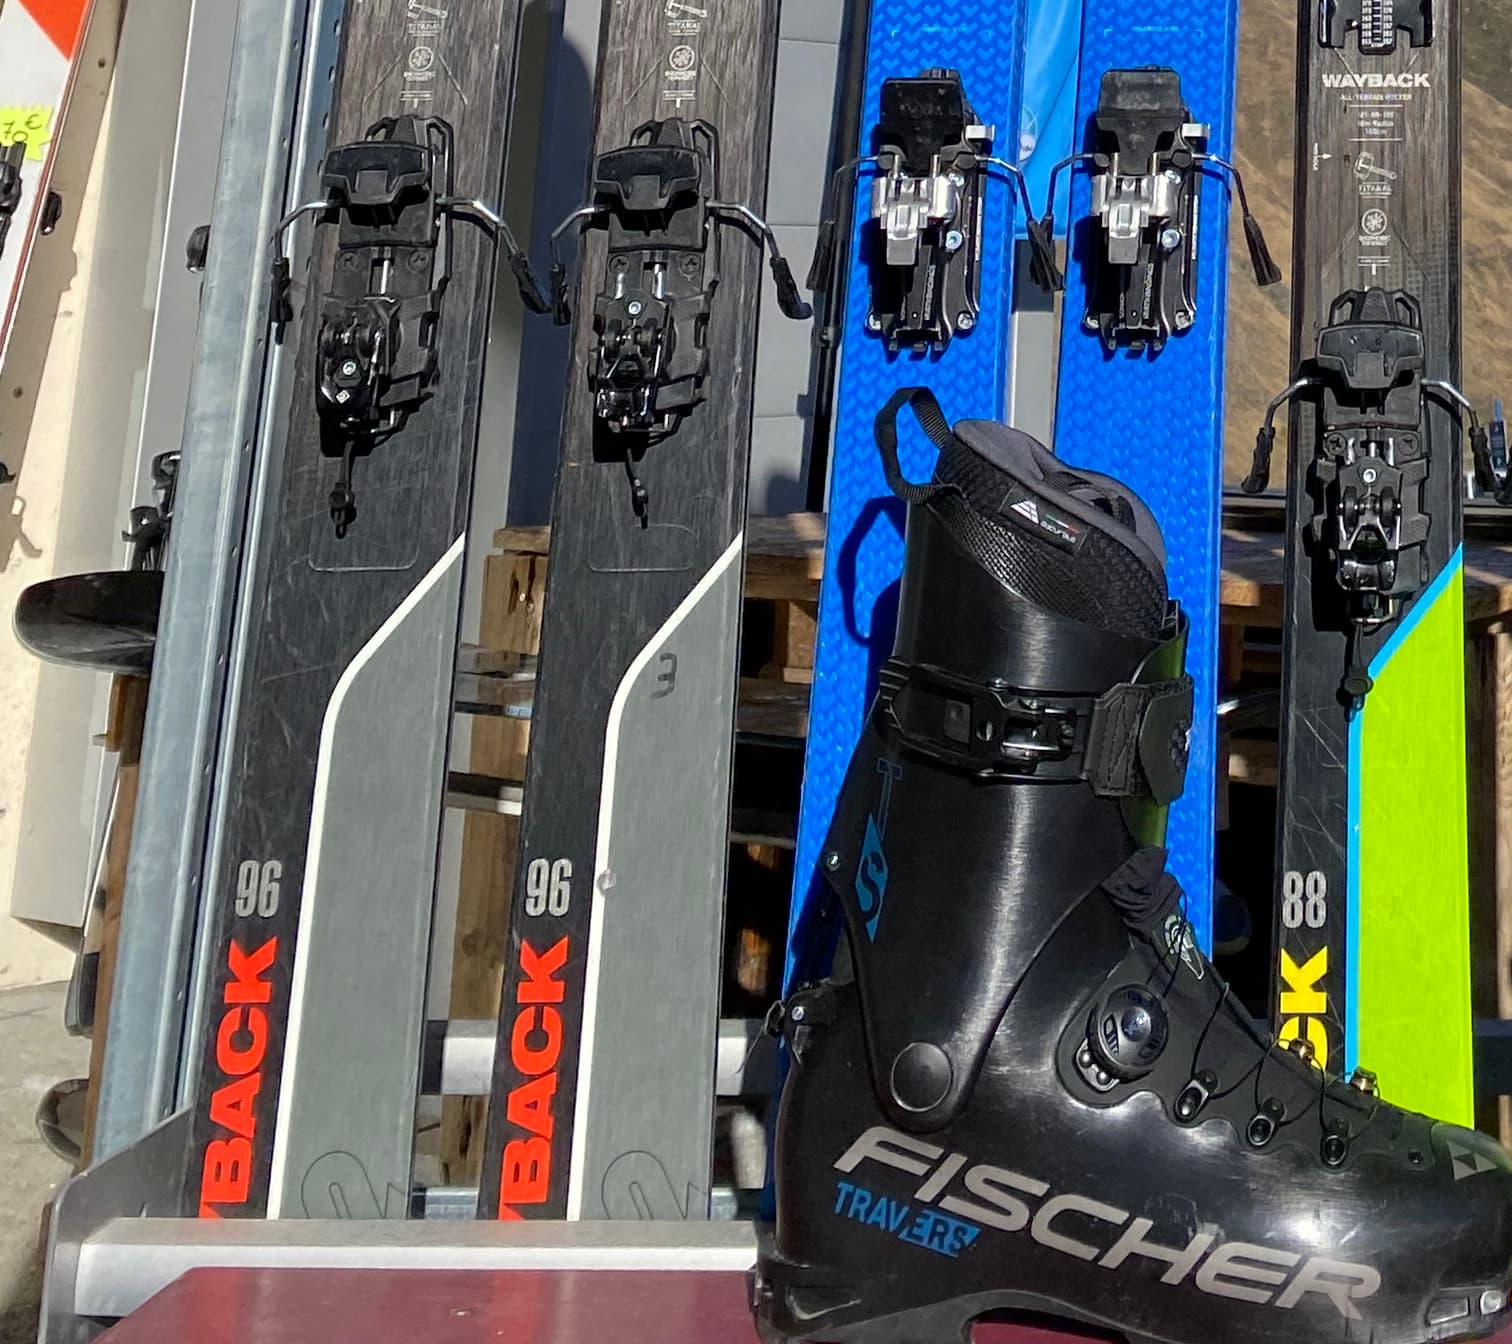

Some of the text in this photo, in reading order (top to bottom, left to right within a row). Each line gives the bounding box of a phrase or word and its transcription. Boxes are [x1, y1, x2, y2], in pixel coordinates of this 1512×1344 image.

[1322, 73, 1431, 88] WAYBACK
[234, 859, 284, 918] 96
[525, 857, 574, 916] 96
[1282, 870, 1327, 929] 88
[1278, 945, 1329, 1074] CK
[200, 935, 279, 1219] BACK
[499, 935, 570, 1220] BACK
[833, 1181, 981, 1258] TRAVERS
[833, 1125, 1382, 1320] FISCHER
